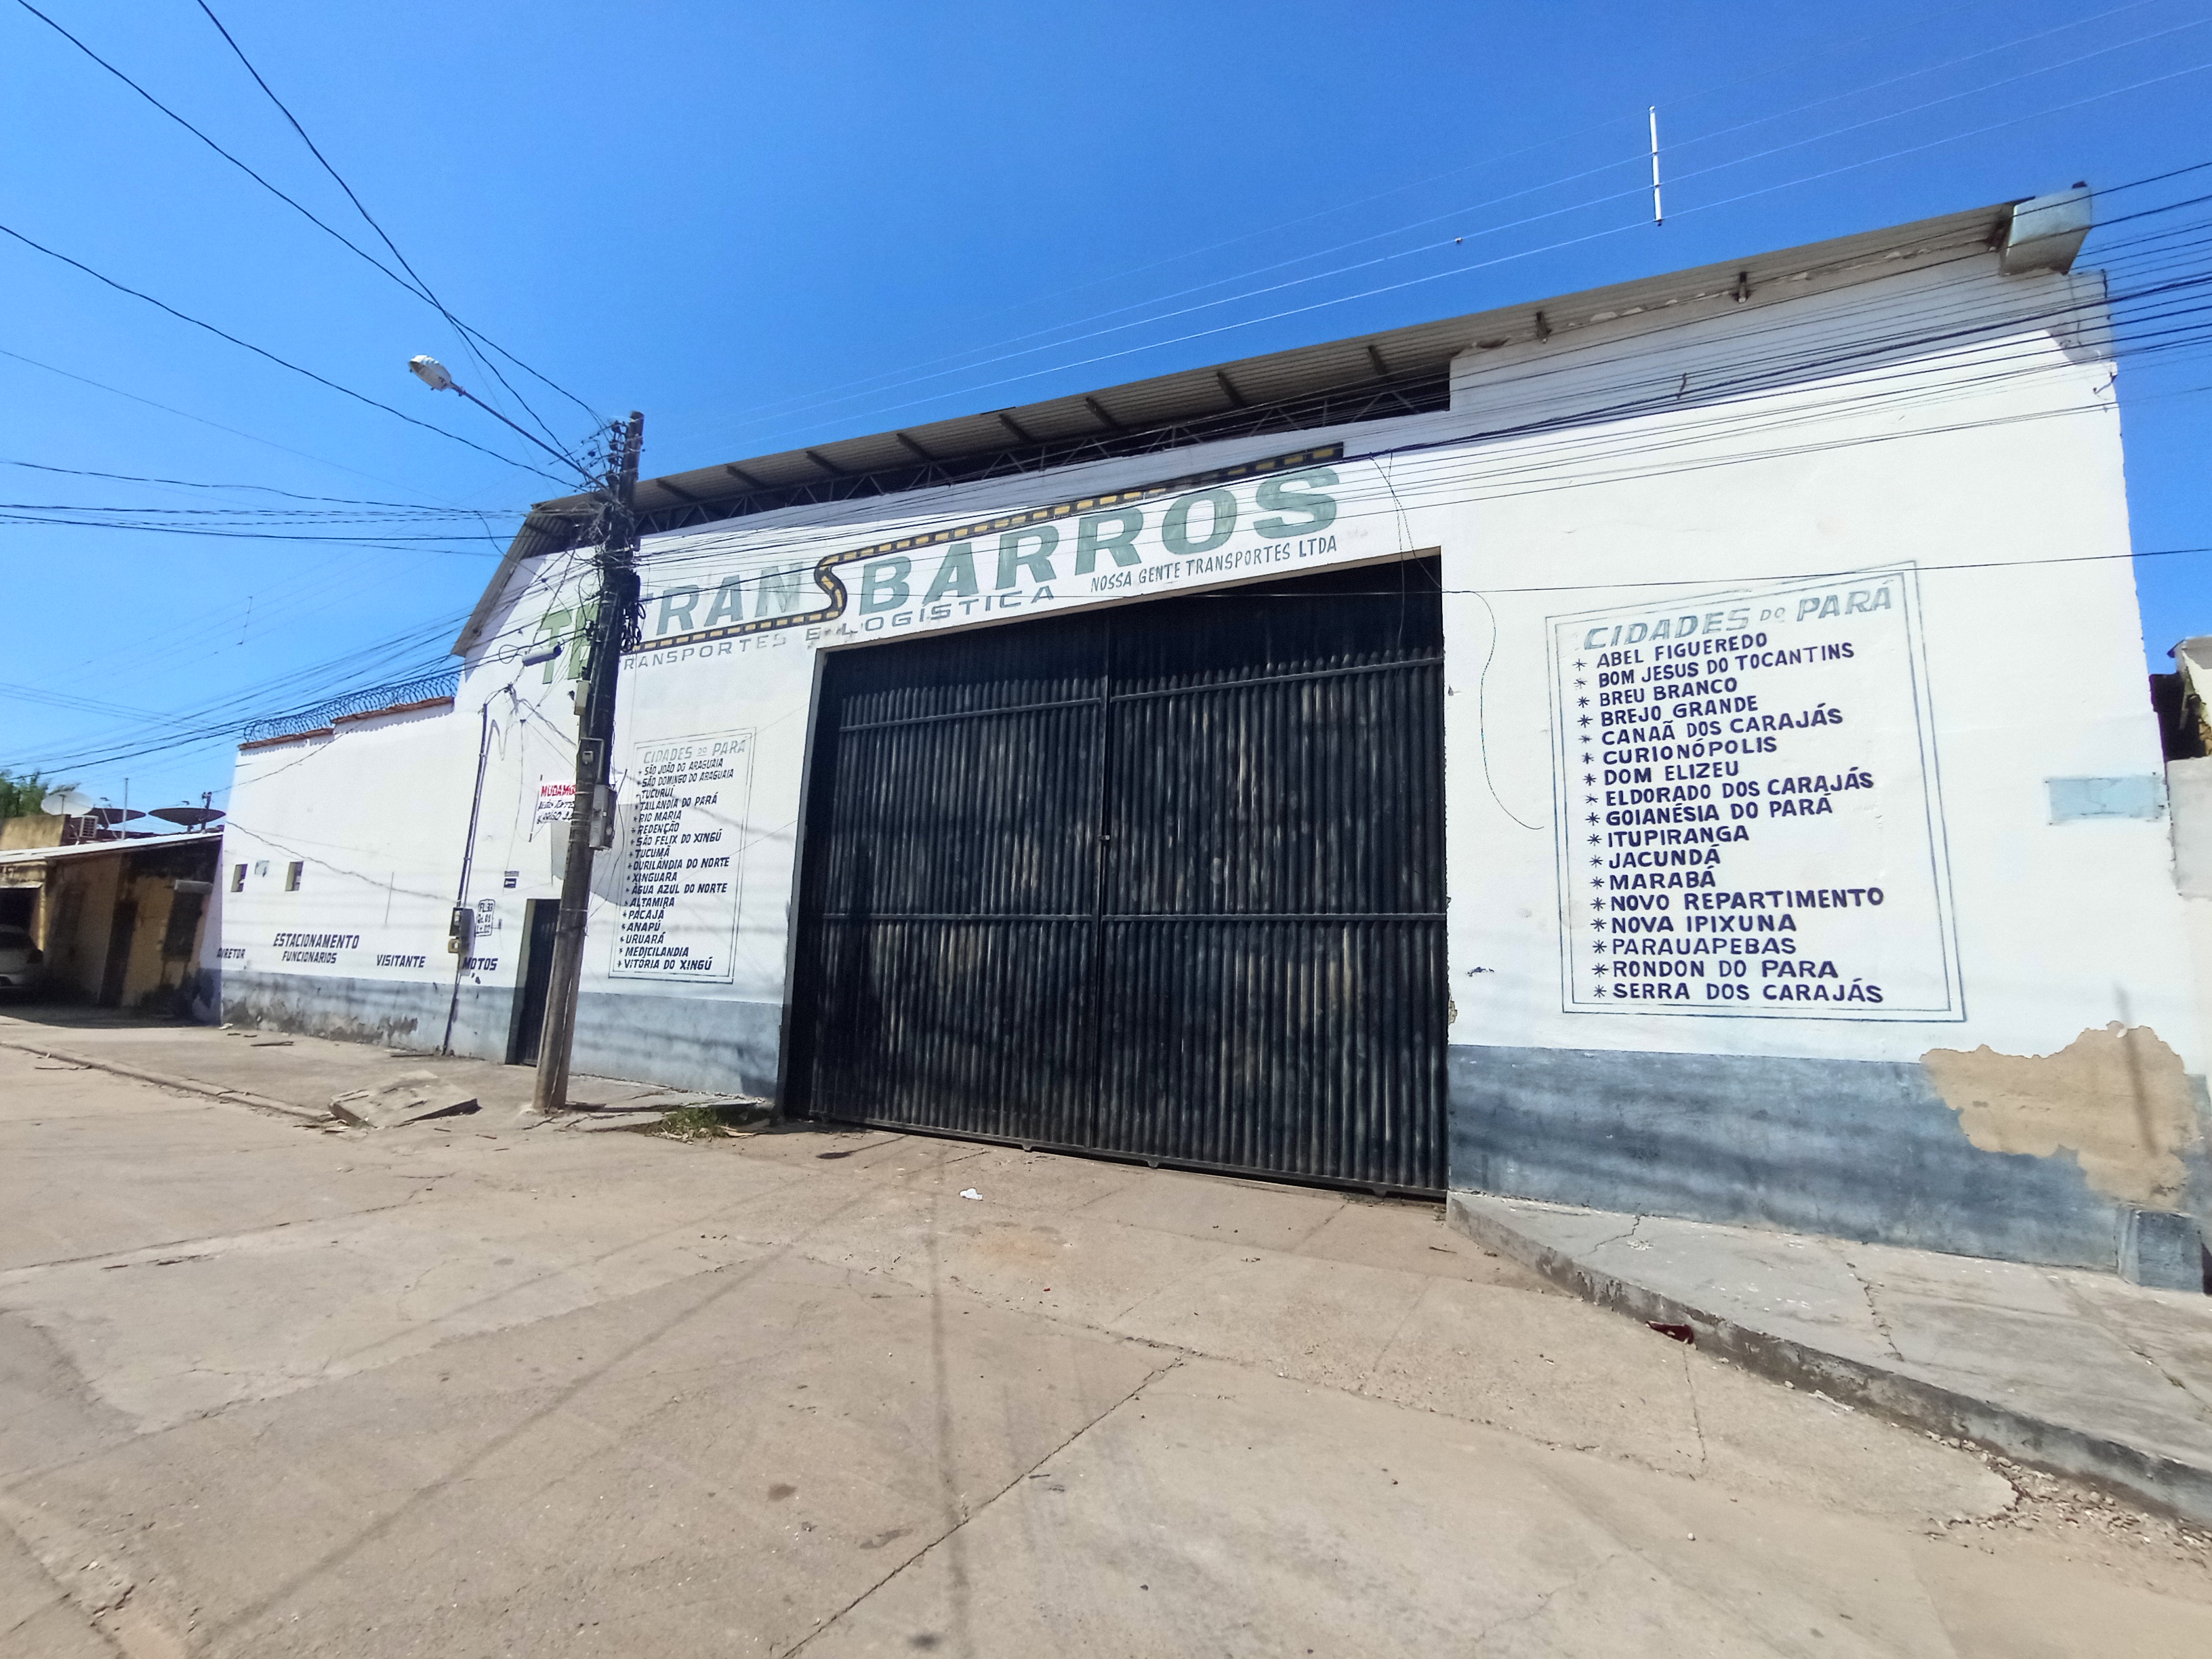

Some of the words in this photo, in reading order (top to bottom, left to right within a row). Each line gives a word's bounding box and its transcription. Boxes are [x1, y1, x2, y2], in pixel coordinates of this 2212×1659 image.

[1091, 571, 1132, 593] NOSSA
[1139, 562, 1181, 583] GENTE
[1185, 542, 1290, 577] TRANSPORTES
[1298, 535, 1337, 558] LTDA
[1584, 608, 1750, 651] CIDADES
[1796, 579, 1893, 621] PARÁ
[805, 627, 821, 641] E
[1597, 649, 1644, 668] ABEL
[1655, 632, 1767, 662] FIGUEREDO
[1599, 672, 1635, 688] BOM
[1641, 662, 1699, 683] JESUS
[1706, 658, 1729, 674] DO
[1734, 642, 1855, 671] TOCANTINS
[1599, 688, 1645, 707] BREU
[1653, 677, 1738, 701] BRANCO
[1601, 705, 1662, 727] BREJO
[1673, 695, 1758, 718] GRANDE
[1601, 720, 1676, 745] CANAÃ
[1687, 720, 1722, 738] DOS
[1729, 703, 1843, 733] CARAJÁS
[643, 746, 693, 764] CIDADES
[1603, 736, 1778, 764] CURIONÓPOLIS
[644, 764, 657, 775] SÃO
[657, 762, 675, 775] JOÃO
[676, 762, 686, 773] DO
[689, 758, 724, 771] ARAGUAIA
[1604, 767, 1652, 785] DOM
[1664, 760, 1740, 782] ELIZEU
[642, 775, 656, 787] SÃO
[689, 773, 697, 783] DO
[699, 769, 734, 781] ARAGUAIA
[1606, 784, 1711, 806] ELDORADO
[1722, 781, 1761, 799] DOS
[1767, 767, 1875, 796] CARAJÁS
[641, 785, 676, 799] TUCURUÍ
[681, 797, 692, 808] DO
[694, 792, 718, 806] PARÁ
[638, 813, 653, 823] RIO
[654, 810, 682, 821] MARIA
[1605, 802, 1719, 826] GOIANÉSIA
[1731, 801, 1758, 819] DO
[1769, 792, 1833, 817] PARÁ
[637, 820, 680, 835] REDENÇÃO
[1607, 825, 1750, 848] ITUPIRANGA
[636, 834, 653, 846] SÃO
[680, 834, 691, 844] DO
[693, 828, 723, 843] XINGÚ
[634, 845, 671, 859] TUCUMÃ
[1608, 844, 1721, 869] JACUNDÁ
[633, 857, 682, 871] OURILÂNDIA
[686, 858, 698, 869] DO
[700, 857, 730, 869] NORTE
[632, 872, 678, 882] XINGUARA
[1610, 865, 1717, 890] MARABÁ
[657, 884, 680, 895] AZUL
[684, 884, 695, 894] DO
[697, 883, 728, 893] NORTE
[629, 897, 675, 907] ALTAMIRA
[1610, 894, 1670, 912] NOVO
[1684, 887, 1885, 910] REPARTIMENTO
[626, 920, 661, 932] ANAPÚ
[1611, 916, 1674, 934] NOVA
[1686, 914, 1797, 933] IPIXUNA
[272, 933, 360, 949] ESTACIONAMENTO
[626, 931, 666, 944] URUARÁ
[1612, 937, 1797, 956] PARAUAPEBAS
[281, 950, 337, 964] FUNCIONARIOS
[376, 954, 426, 968] VISITANTE
[462, 957, 498, 970] MOTOS
[624, 956, 660, 968] VITÓRIA
[663, 959, 676, 970] DO
[679, 956, 714, 970] XINGÚ
[1613, 960, 1704, 977] RONDON
[1719, 960, 1746, 977] DO
[1761, 960, 1839, 979] PARA
[1612, 982, 1690, 1000] SERRA
[1706, 983, 1750, 1000] DOS
[1762, 978, 1884, 1004] CARAJÁS
